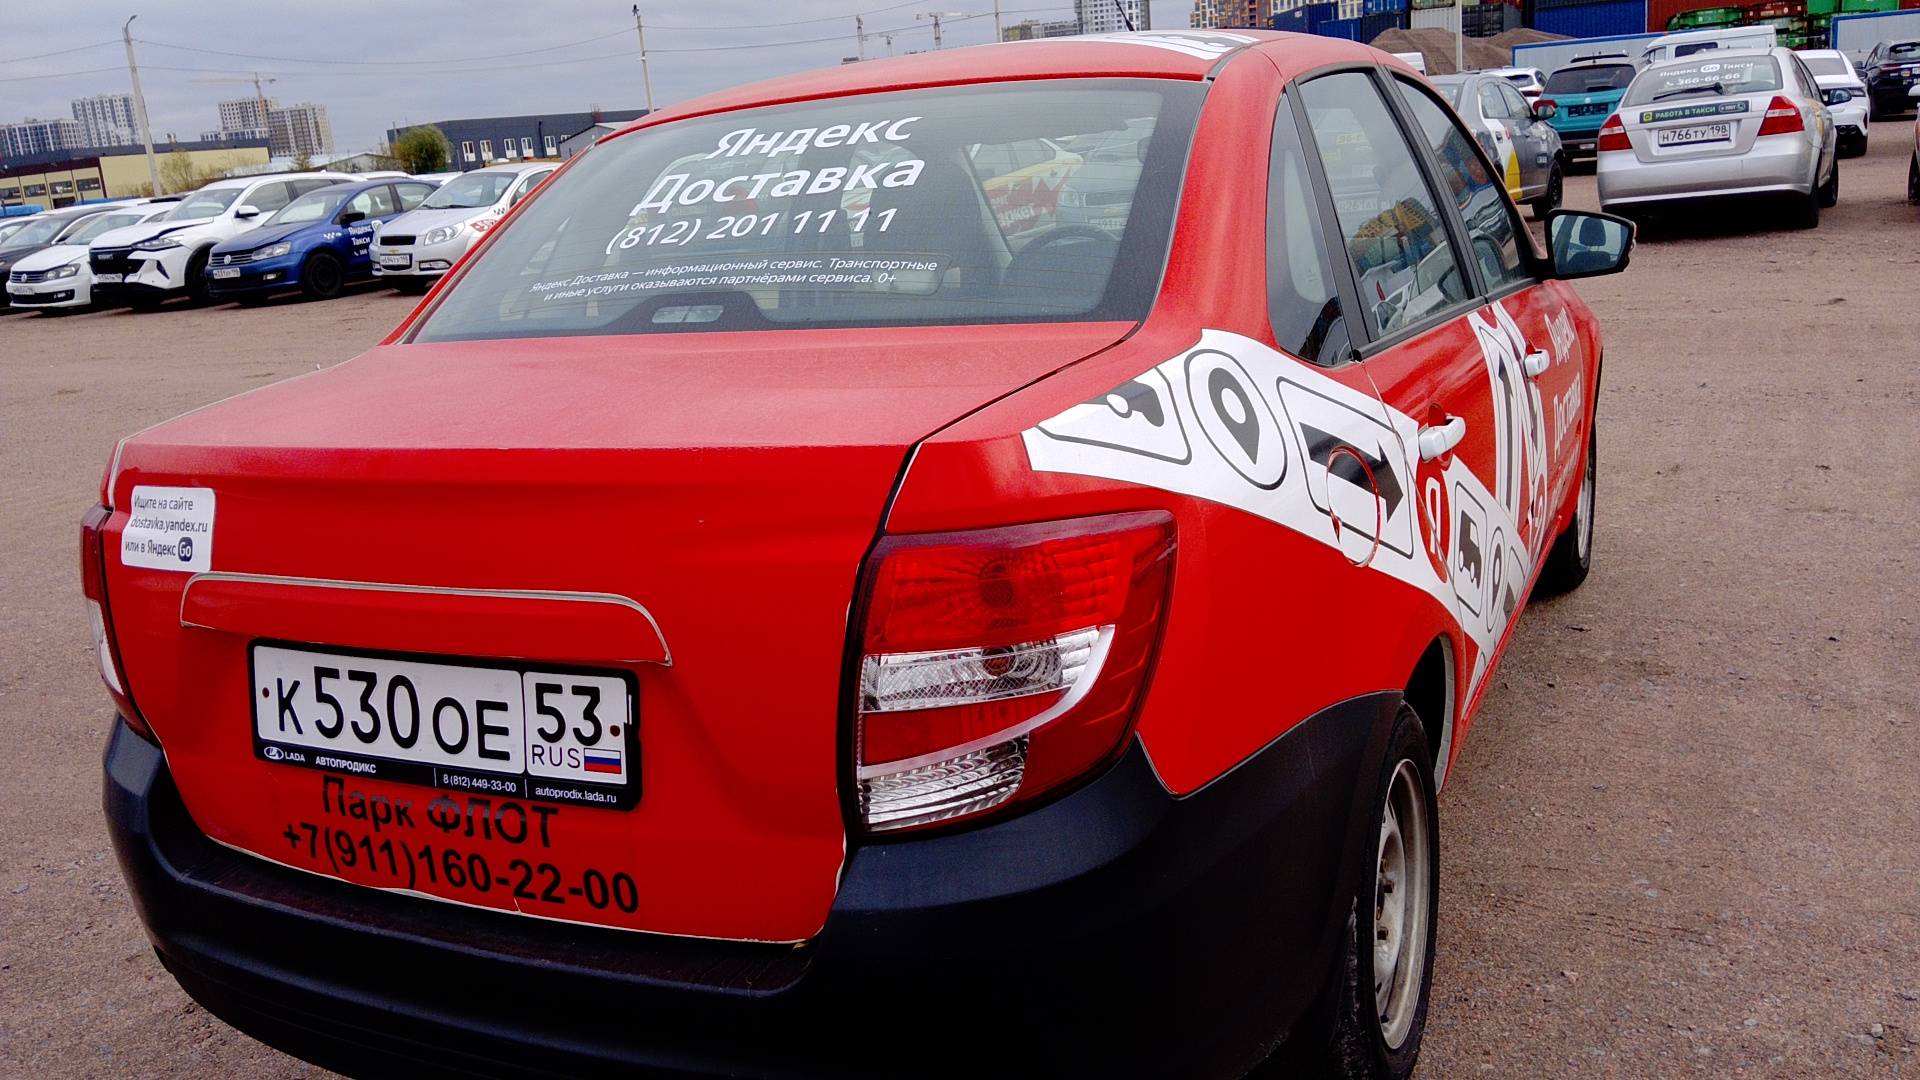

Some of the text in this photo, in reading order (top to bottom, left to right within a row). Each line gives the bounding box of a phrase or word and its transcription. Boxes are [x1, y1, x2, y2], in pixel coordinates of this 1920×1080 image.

[1655, 110, 1682, 119] РАБОТА
[1692, 105, 1716, 114] ТАКСИ
[705, 116, 923, 160] Яндекс
[629, 159, 925, 216] Доставка
[606, 207, 897, 254] (812) 201 11 11
[351, 237, 370, 246] Такси
[529, 278, 571, 293] Яндекс
[571, 269, 629, 287] Доставка
[645, 259, 768, 277] информационный
[769, 258, 823, 271] сервис.
[829, 257, 938, 272] Транспортные
[553, 287, 583, 299] иные
[584, 283, 630, 298] услуги
[630, 276, 717, 291] оказываются
[718, 271, 807, 286] партнёрами
[808, 273, 873, 286] сервиса.
[877, 272, 897, 283] 0+
[134, 495, 194, 510] Ищите на сайте
[130, 515, 208, 533] dostavka.yandex.ru
[125, 540, 192, 558] или в Яндекс Go
[535, 682, 603, 747] 53
[284, 751, 306, 762] LADA
[315, 756, 377, 774] АВТОПРОДИКС
[532, 744, 581, 769] RUS
[443, 775, 517, 793] 8 (812) 449-33-00
[535, 786, 617, 803] autoprodix.lada.ru
[322, 775, 559, 848] Парк ФЛОТ
[282, 822, 640, 915] +7(911)160-22-00
